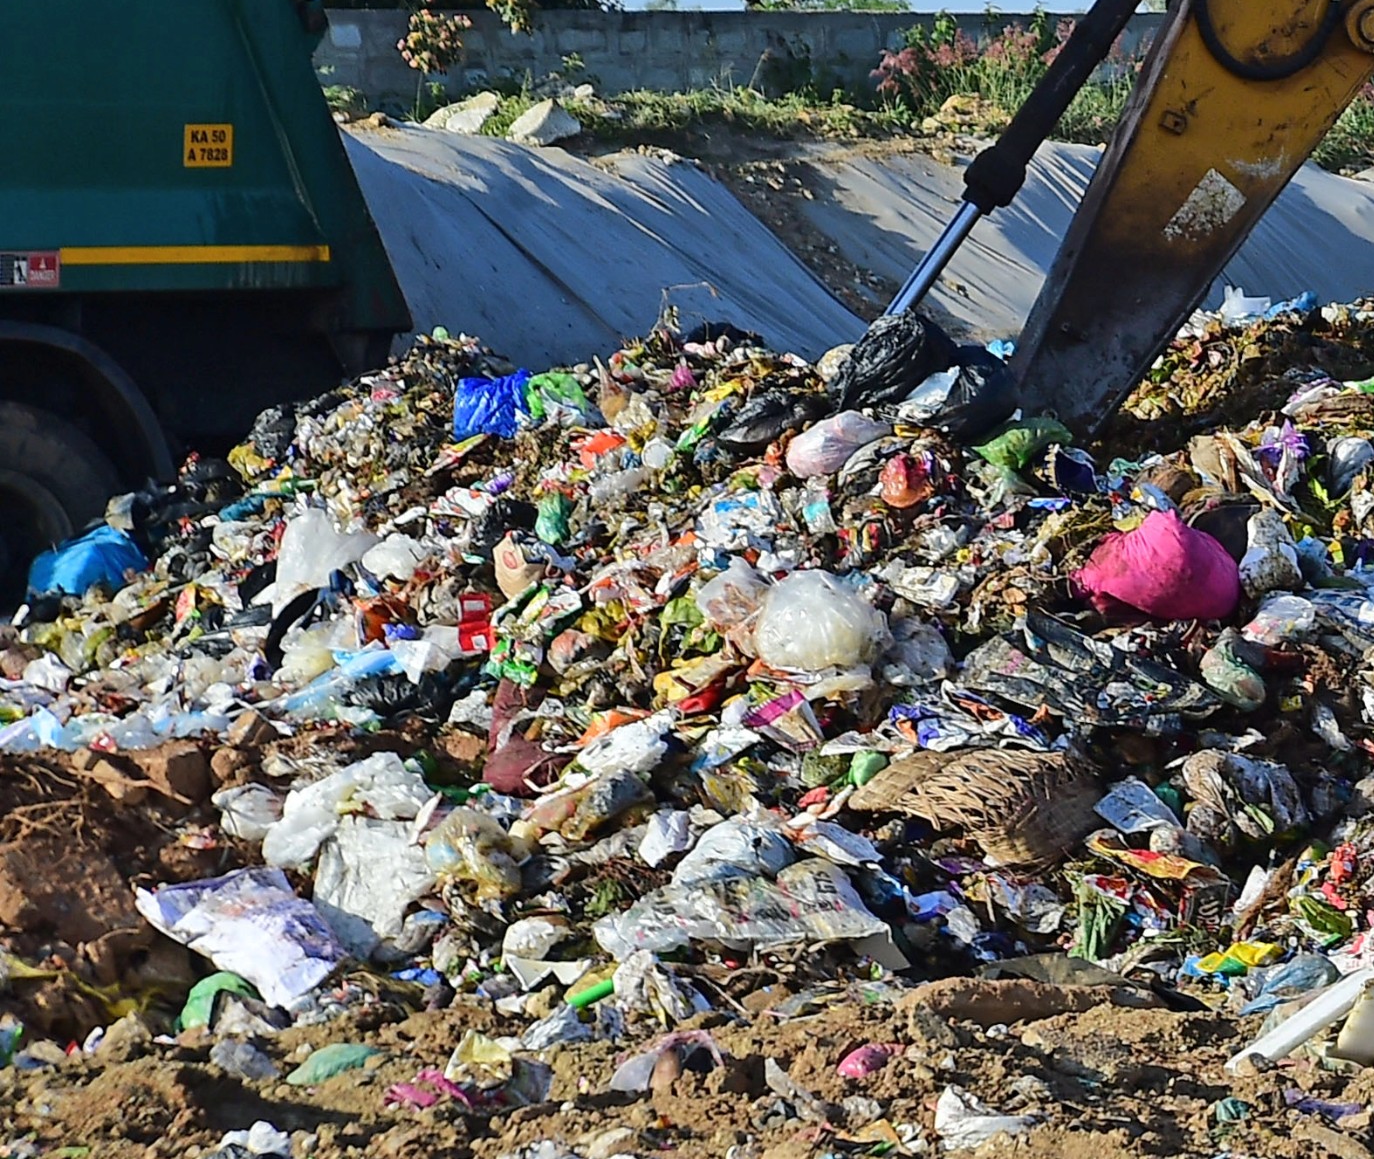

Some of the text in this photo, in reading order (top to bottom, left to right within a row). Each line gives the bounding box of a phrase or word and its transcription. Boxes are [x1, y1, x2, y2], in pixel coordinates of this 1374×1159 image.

[190, 130, 226, 143] KA 50
[187, 148, 196, 161] A
